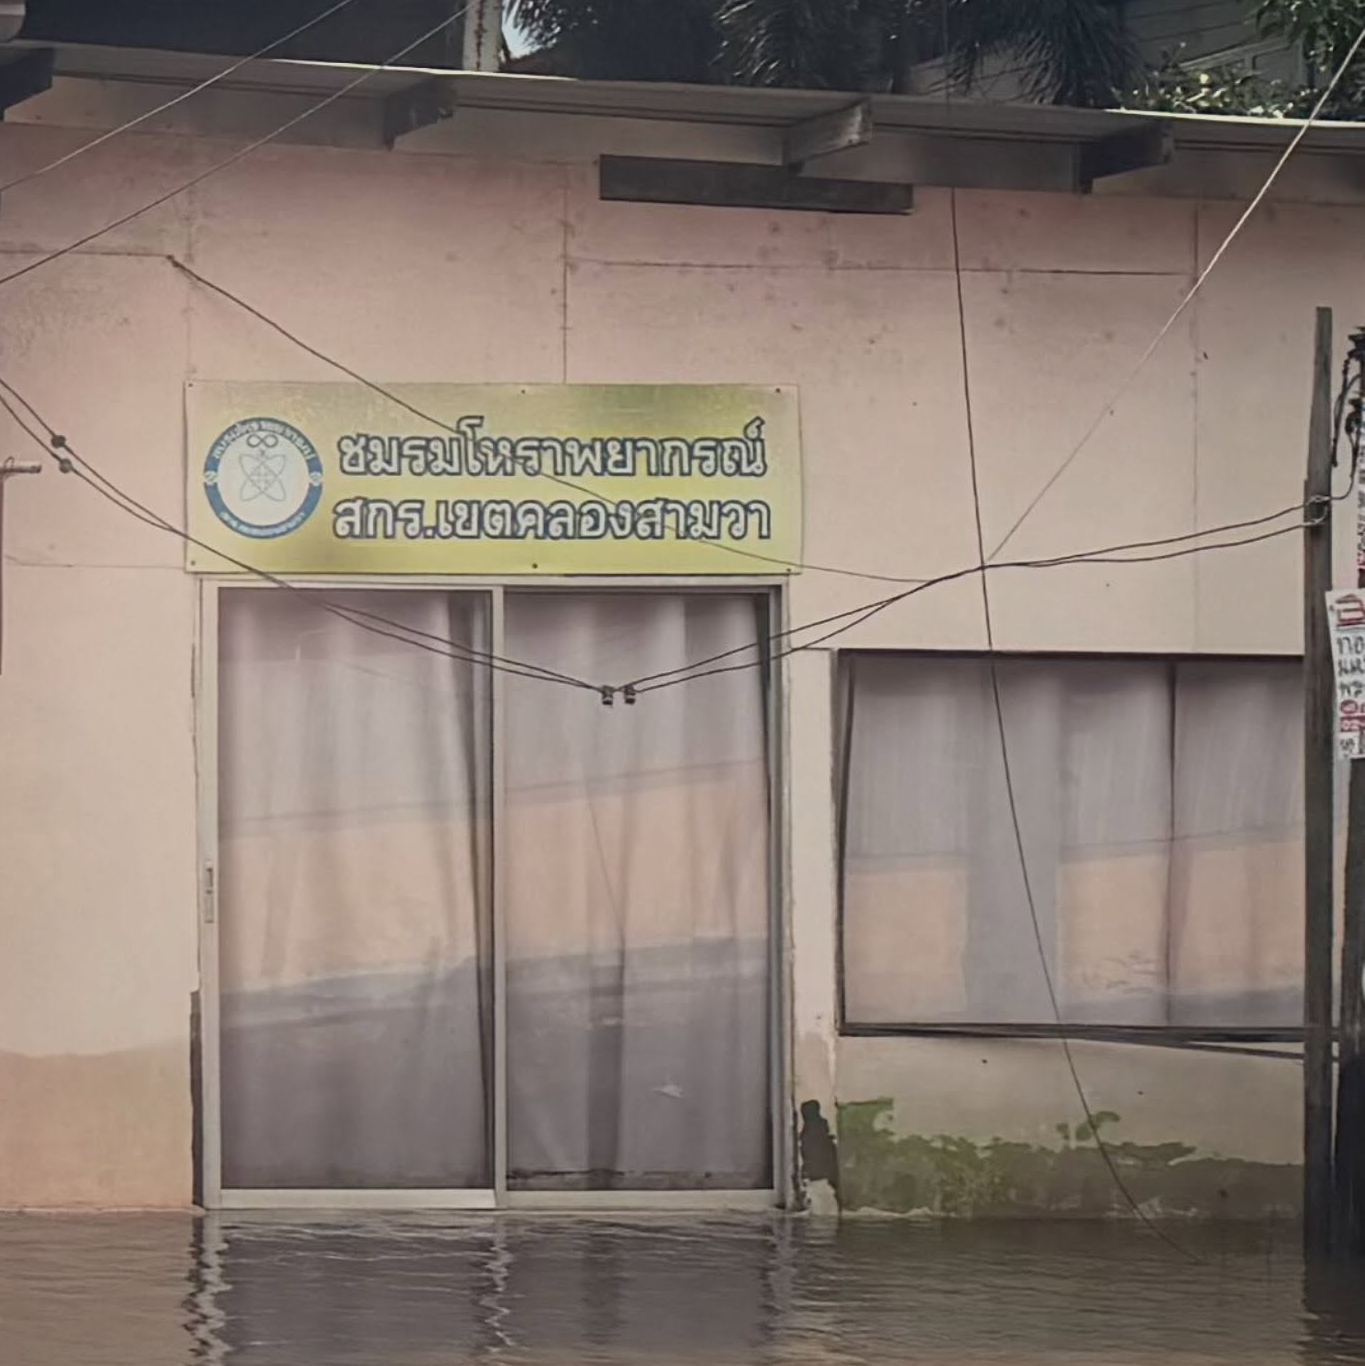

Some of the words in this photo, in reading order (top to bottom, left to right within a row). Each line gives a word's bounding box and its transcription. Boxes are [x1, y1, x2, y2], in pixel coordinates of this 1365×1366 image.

[337, 415, 769, 478] ชมรมโหราพยากรณ์
[332, 496, 773, 541] สกร.เขตคลองสามวา
